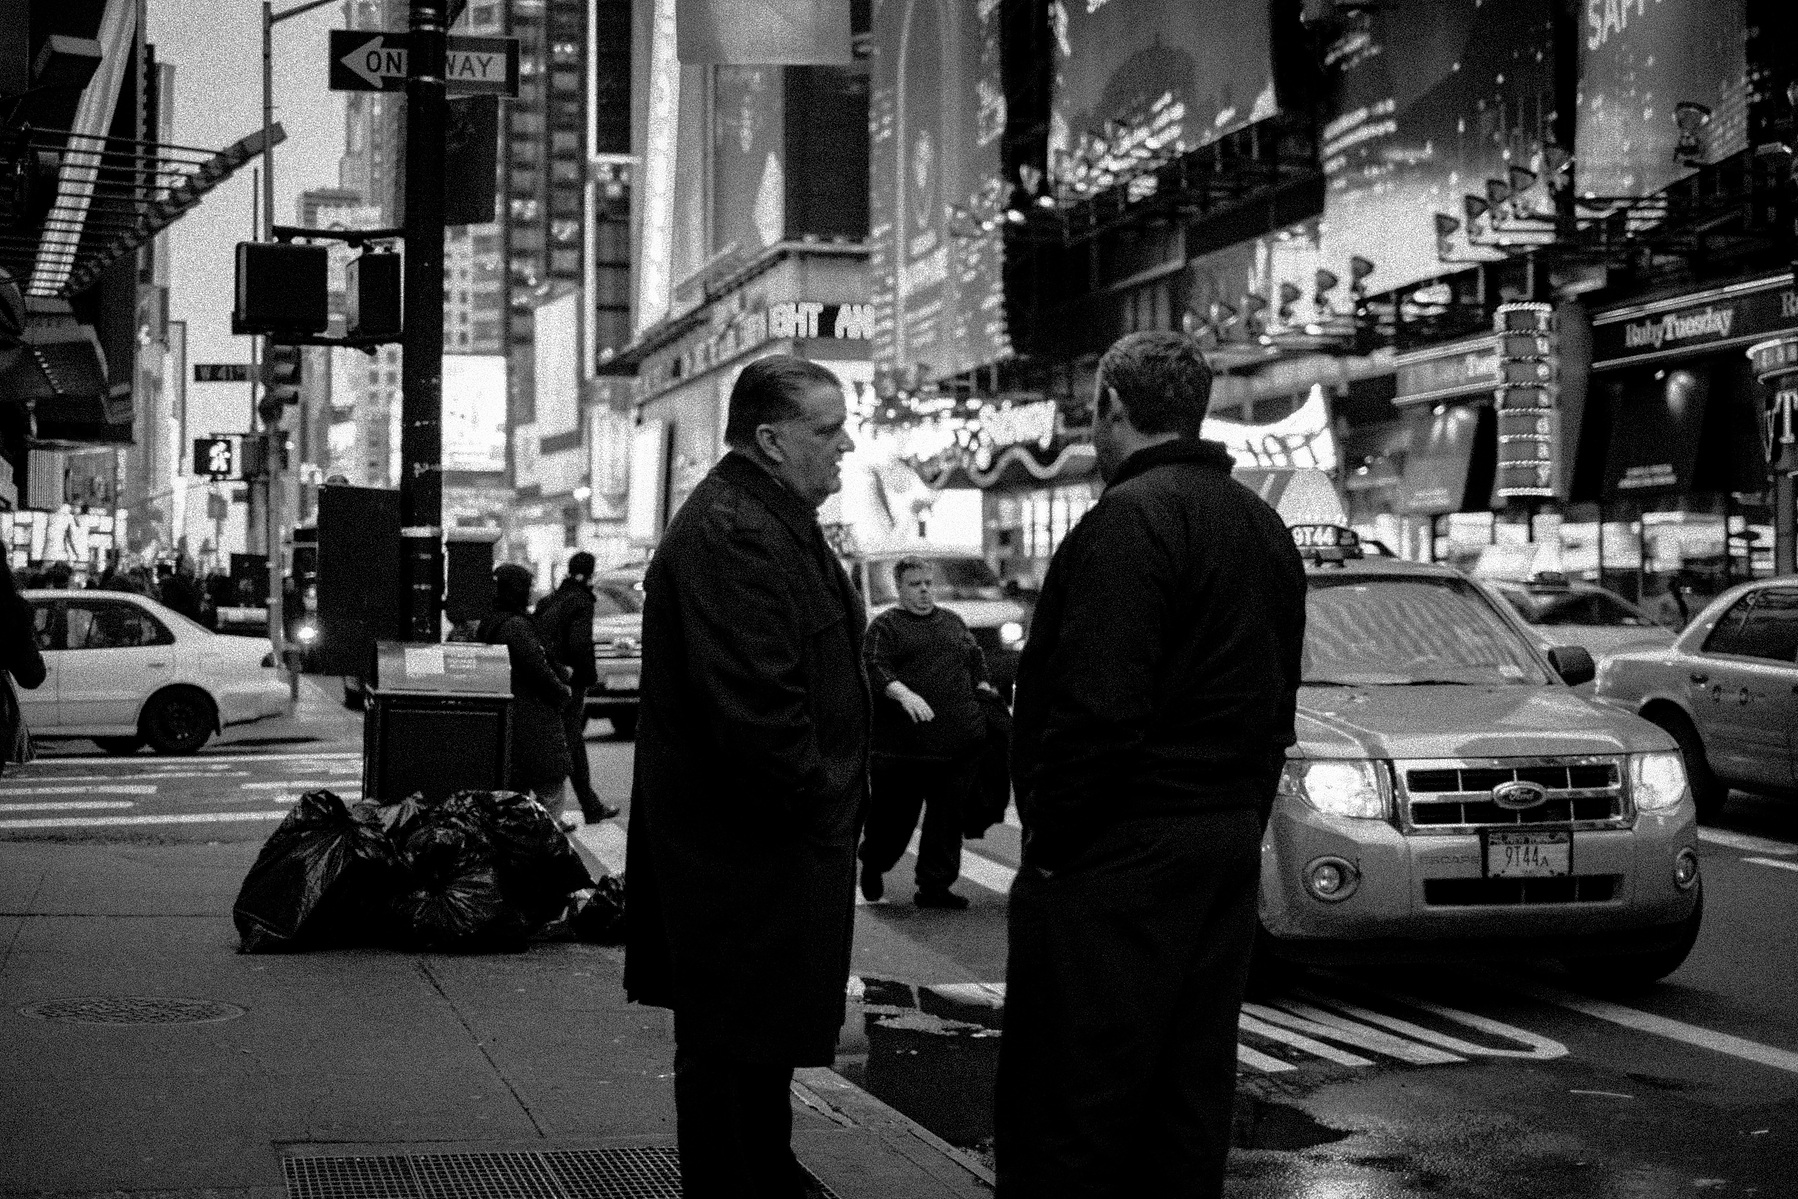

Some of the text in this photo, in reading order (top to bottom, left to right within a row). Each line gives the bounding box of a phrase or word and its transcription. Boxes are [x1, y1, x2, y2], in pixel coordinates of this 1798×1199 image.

[365, 50, 403, 74] ON
[1663, 308, 1734, 341] Tuesday
[1292, 526, 1335, 546] 9T44
